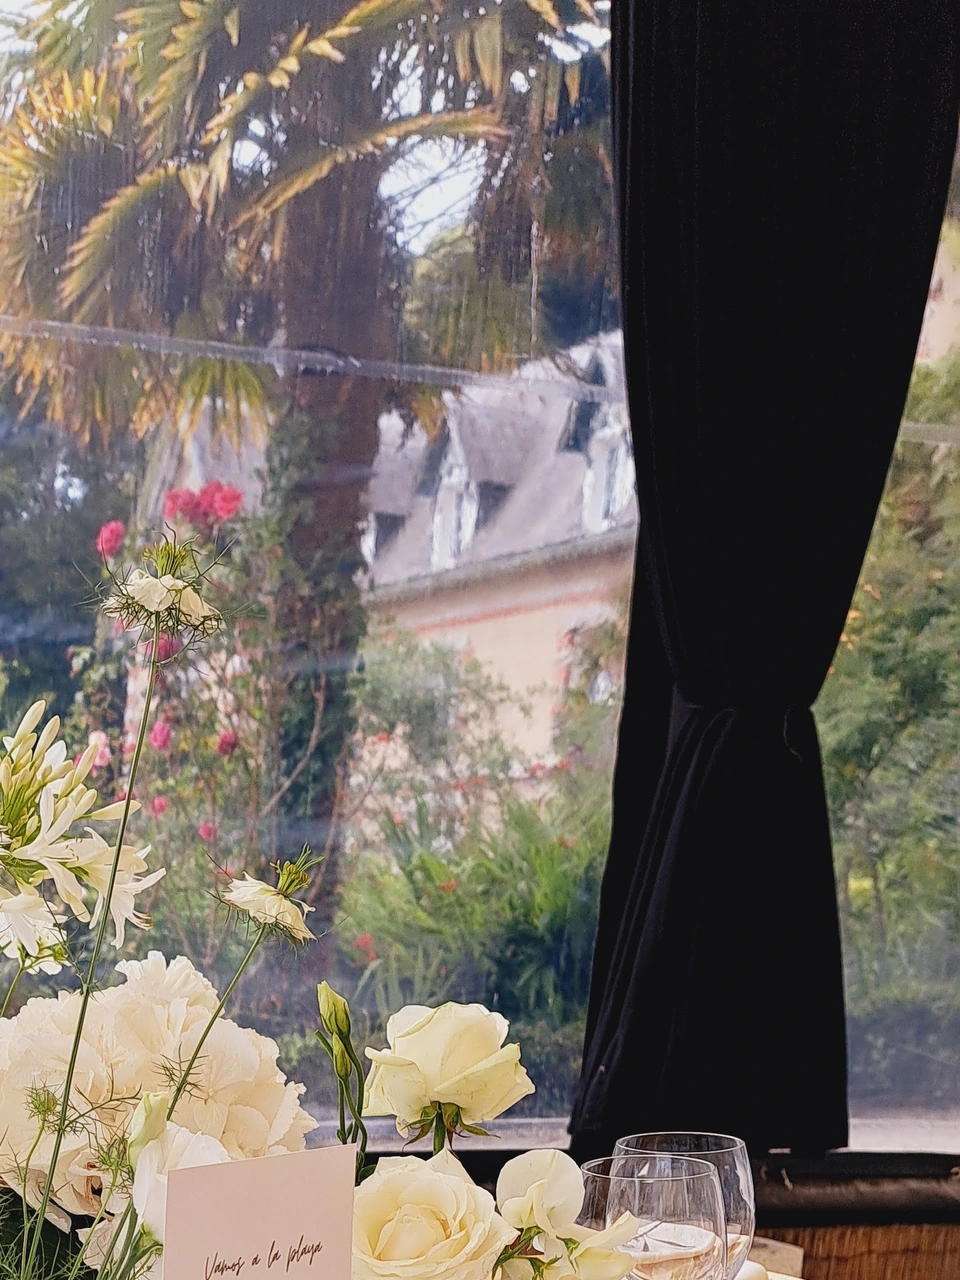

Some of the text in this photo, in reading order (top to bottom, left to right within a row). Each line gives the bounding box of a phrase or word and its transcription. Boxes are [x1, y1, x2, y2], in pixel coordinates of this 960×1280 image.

[251, 1253, 262, 1267] a
[267, 1239, 282, 1269] la
[285, 1233, 324, 1273] playa
